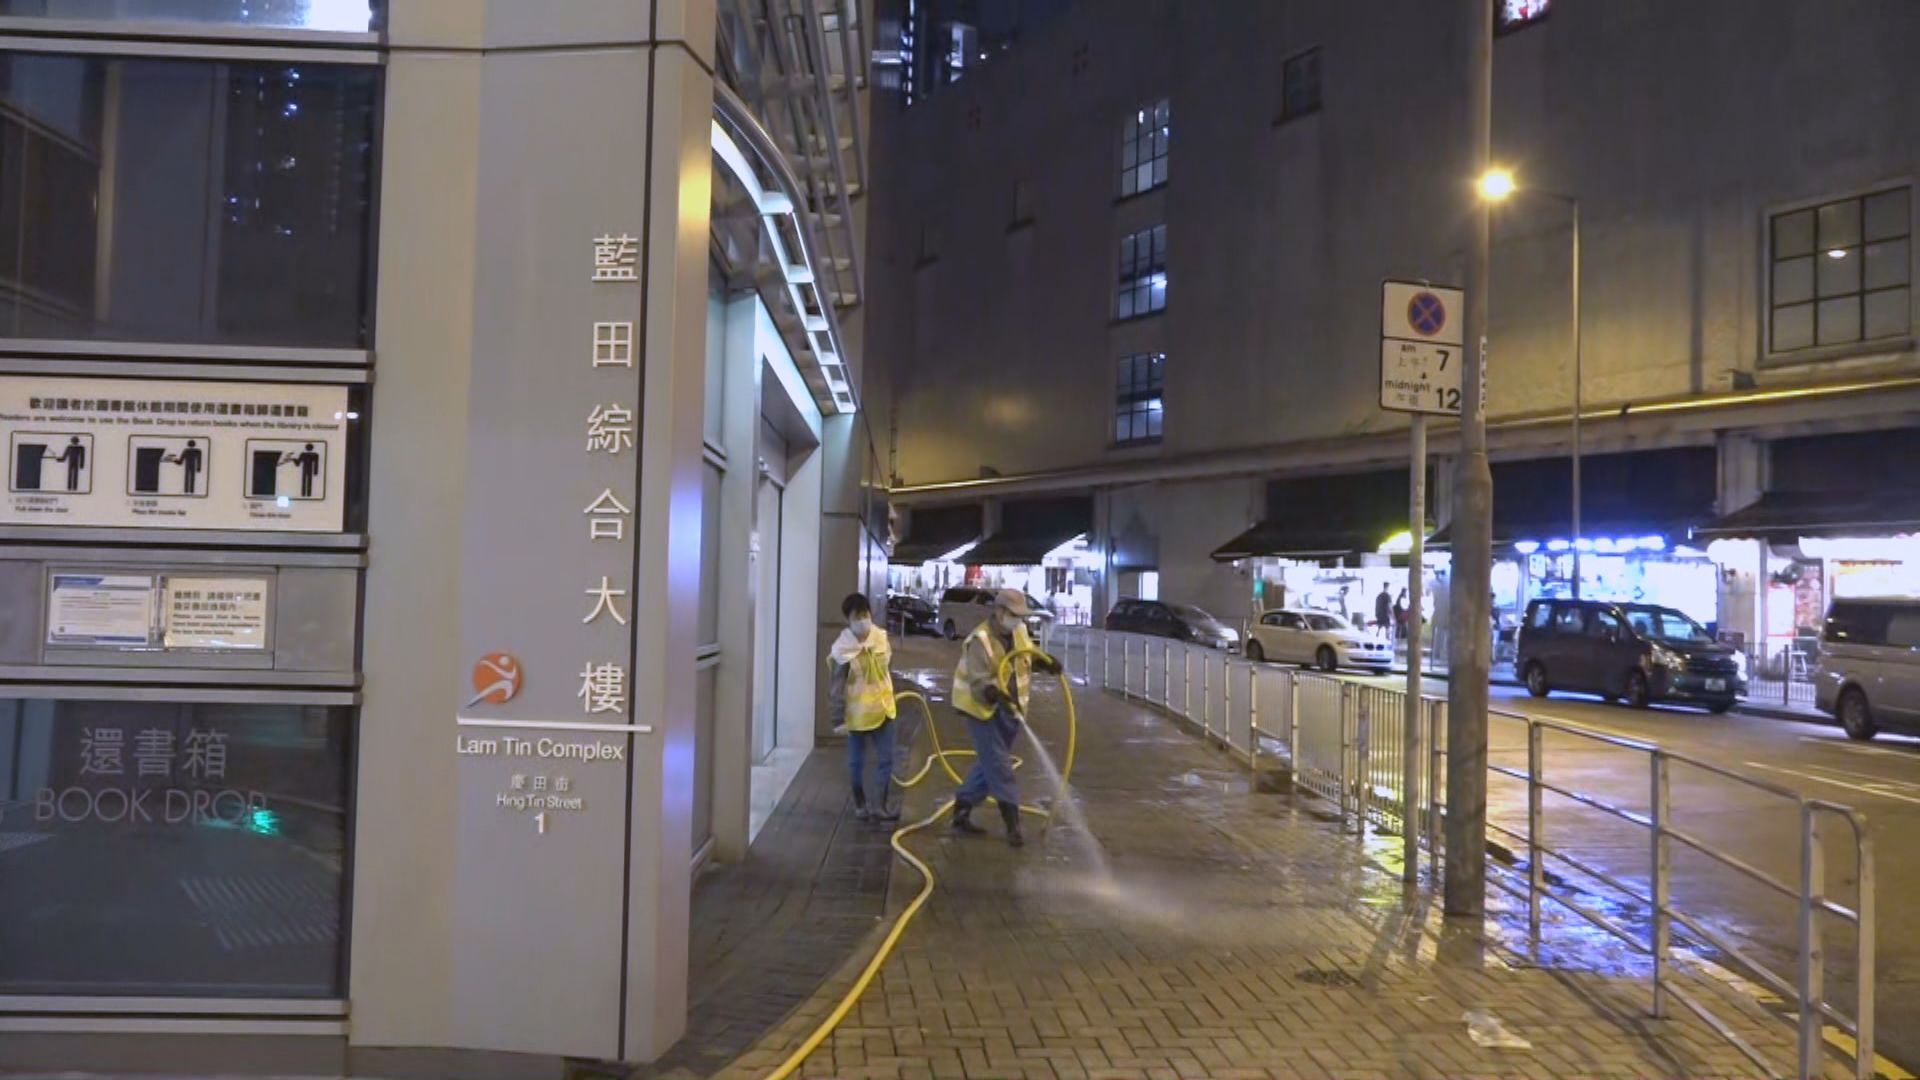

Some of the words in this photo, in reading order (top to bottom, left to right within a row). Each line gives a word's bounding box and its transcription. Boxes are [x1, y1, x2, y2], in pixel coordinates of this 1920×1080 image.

[1436, 350, 1450, 371] 7
[1384, 380, 1431, 394] midnight
[1436, 387, 1461, 409] 12
[578, 233, 639, 714] 藍田綜合大樓
[80, 727, 229, 779] 還書箱
[456, 736, 497, 754] Lam
[502, 738, 532, 756] Tin
[537, 738, 625, 763] Complex
[34, 785, 153, 824] BOOK
[164, 787, 267, 827] DROP
[496, 794, 526, 811] Hing
[526, 795, 545, 808] Tin
[546, 796, 583, 810] Street
[533, 812, 546, 835] 1
